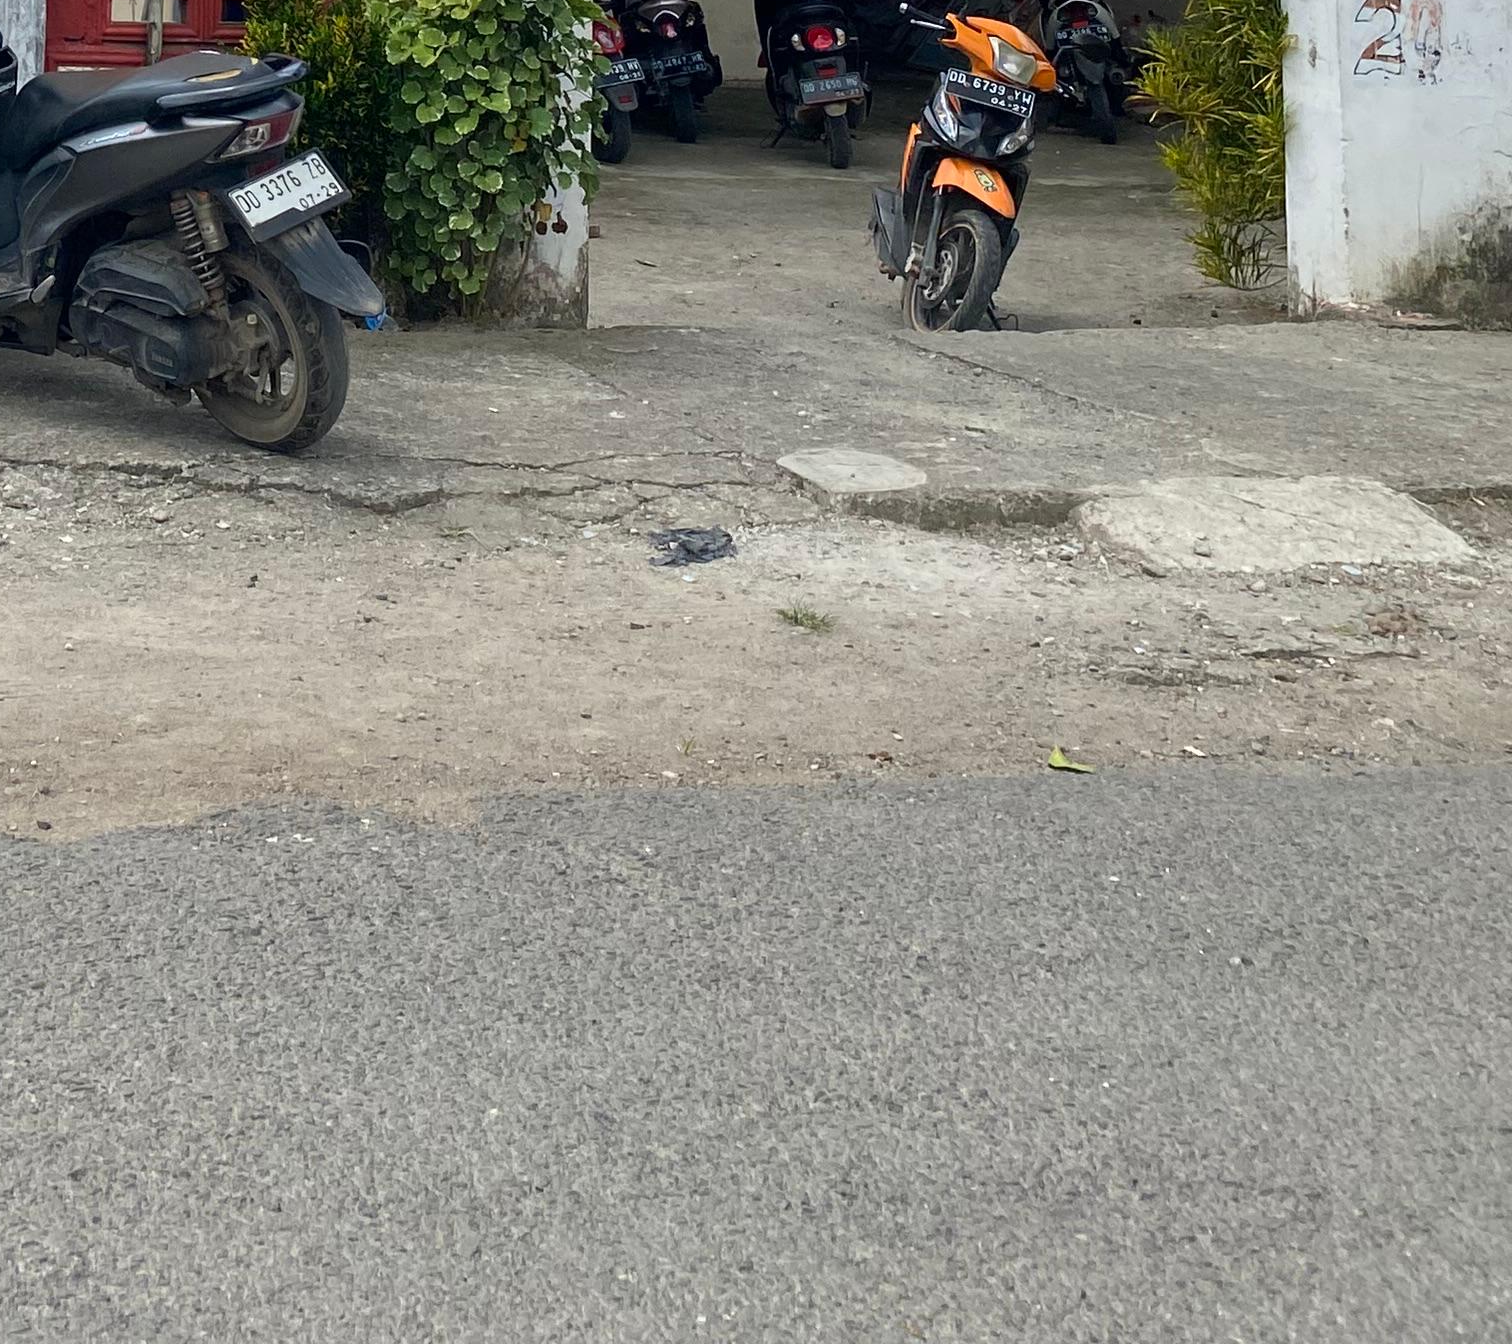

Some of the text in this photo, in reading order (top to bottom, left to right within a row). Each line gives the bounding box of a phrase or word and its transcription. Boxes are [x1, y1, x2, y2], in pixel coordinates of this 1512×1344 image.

[949, 71, 1032, 105] DD 6739 YW
[235, 158, 326, 214] DD 3376 ZB
